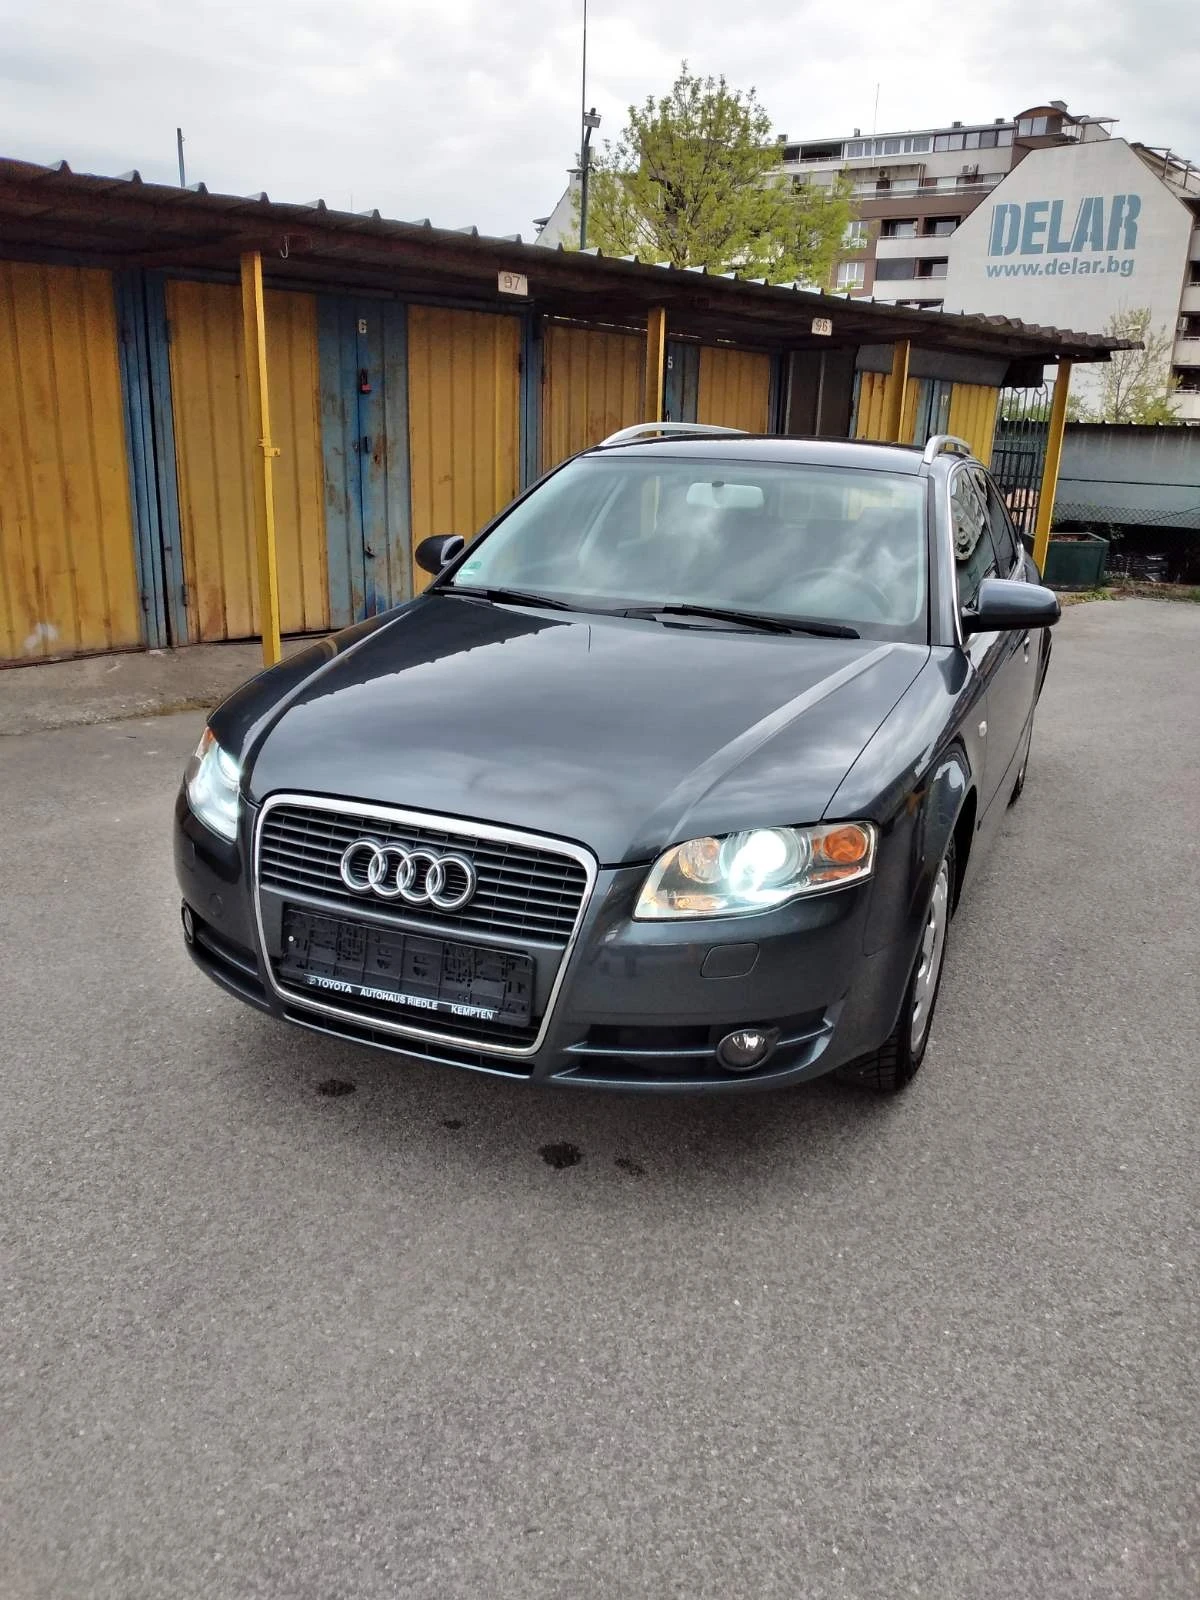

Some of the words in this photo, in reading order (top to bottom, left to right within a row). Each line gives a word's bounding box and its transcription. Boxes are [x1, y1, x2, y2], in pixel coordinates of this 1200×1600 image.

[988, 194, 1142, 257] DELAR
[986, 256, 1135, 277] www.delar.bg
[503, 275, 521, 290] 97
[667, 355, 674, 369] 5
[317, 977, 352, 994] TOYOTA
[359, 987, 406, 1004] AUTOHAUS
[407, 996, 439, 1011] RIEDLE
[450, 1003, 494, 1020] KEMPTEN
